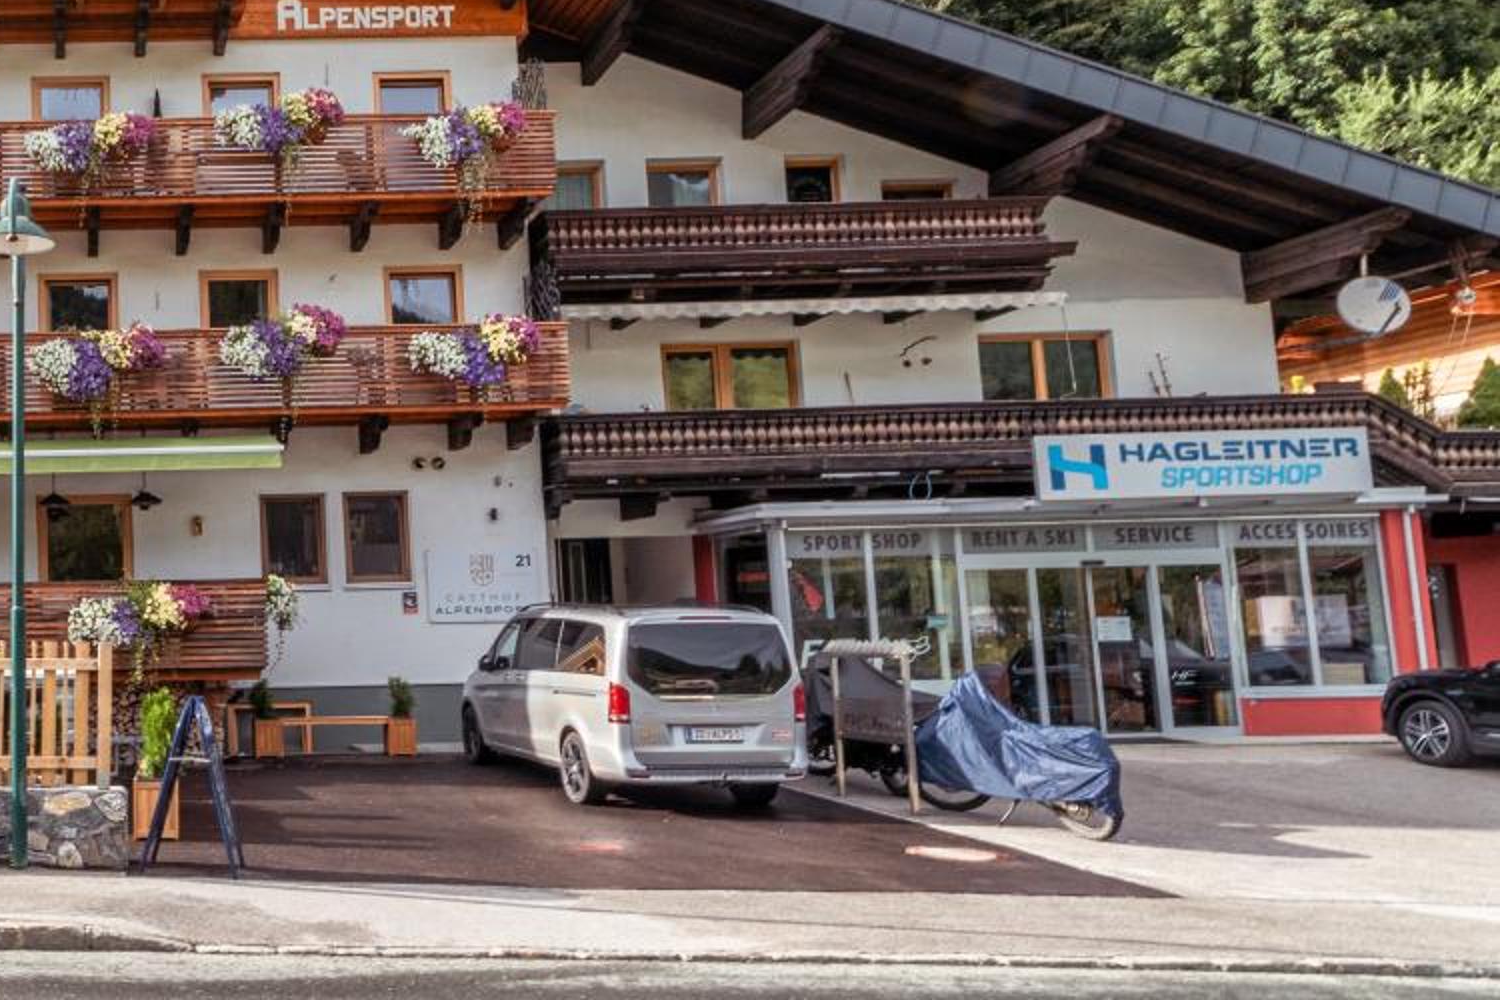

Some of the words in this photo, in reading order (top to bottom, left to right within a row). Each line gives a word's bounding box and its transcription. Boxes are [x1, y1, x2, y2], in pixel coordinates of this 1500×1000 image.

[1119, 437, 1359, 463] HAGLEITNER
[1160, 463, 1323, 488] SPORTSHOP
[803, 534, 862, 551] SPORT
[871, 532, 922, 549] SHOP
[971, 530, 1019, 548] RENT
[1025, 529, 1039, 546] A
[1044, 527, 1076, 545] SKI
[1115, 525, 1195, 544] SERVICE
[515, 554, 531, 567] 21
